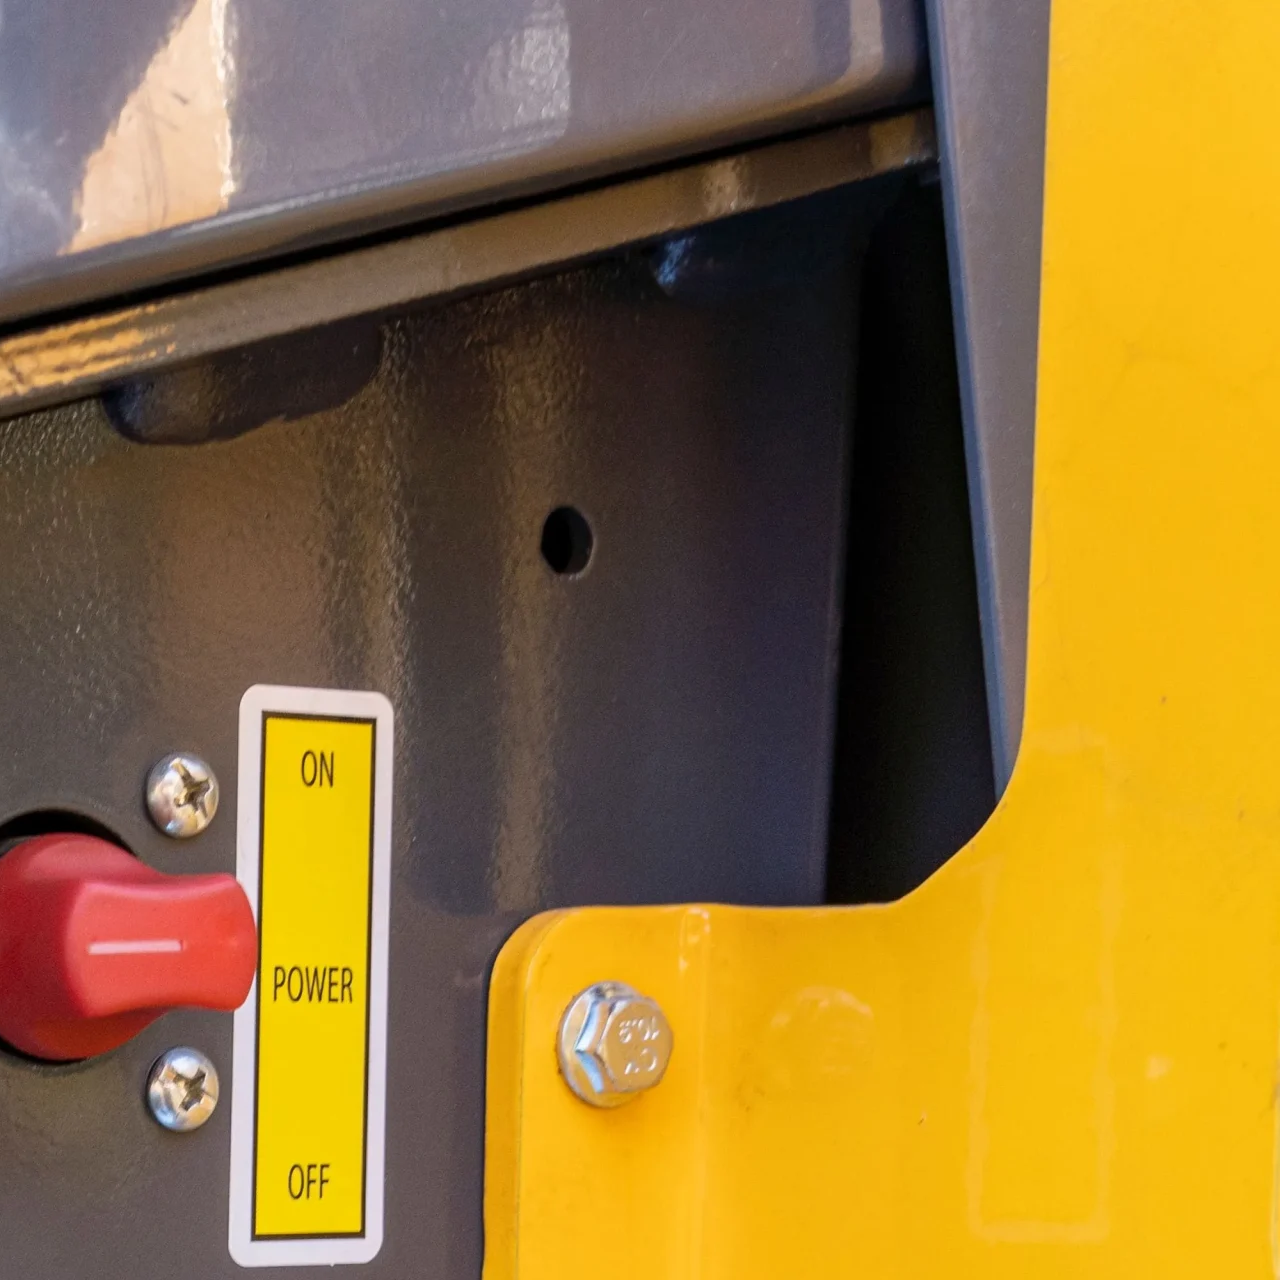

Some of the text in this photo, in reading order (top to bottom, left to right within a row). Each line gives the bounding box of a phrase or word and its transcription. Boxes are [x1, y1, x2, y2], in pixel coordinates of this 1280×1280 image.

[301, 750, 335, 788] ON
[273, 966, 354, 1003] POWER
[288, 1164, 331, 1200] OFF
